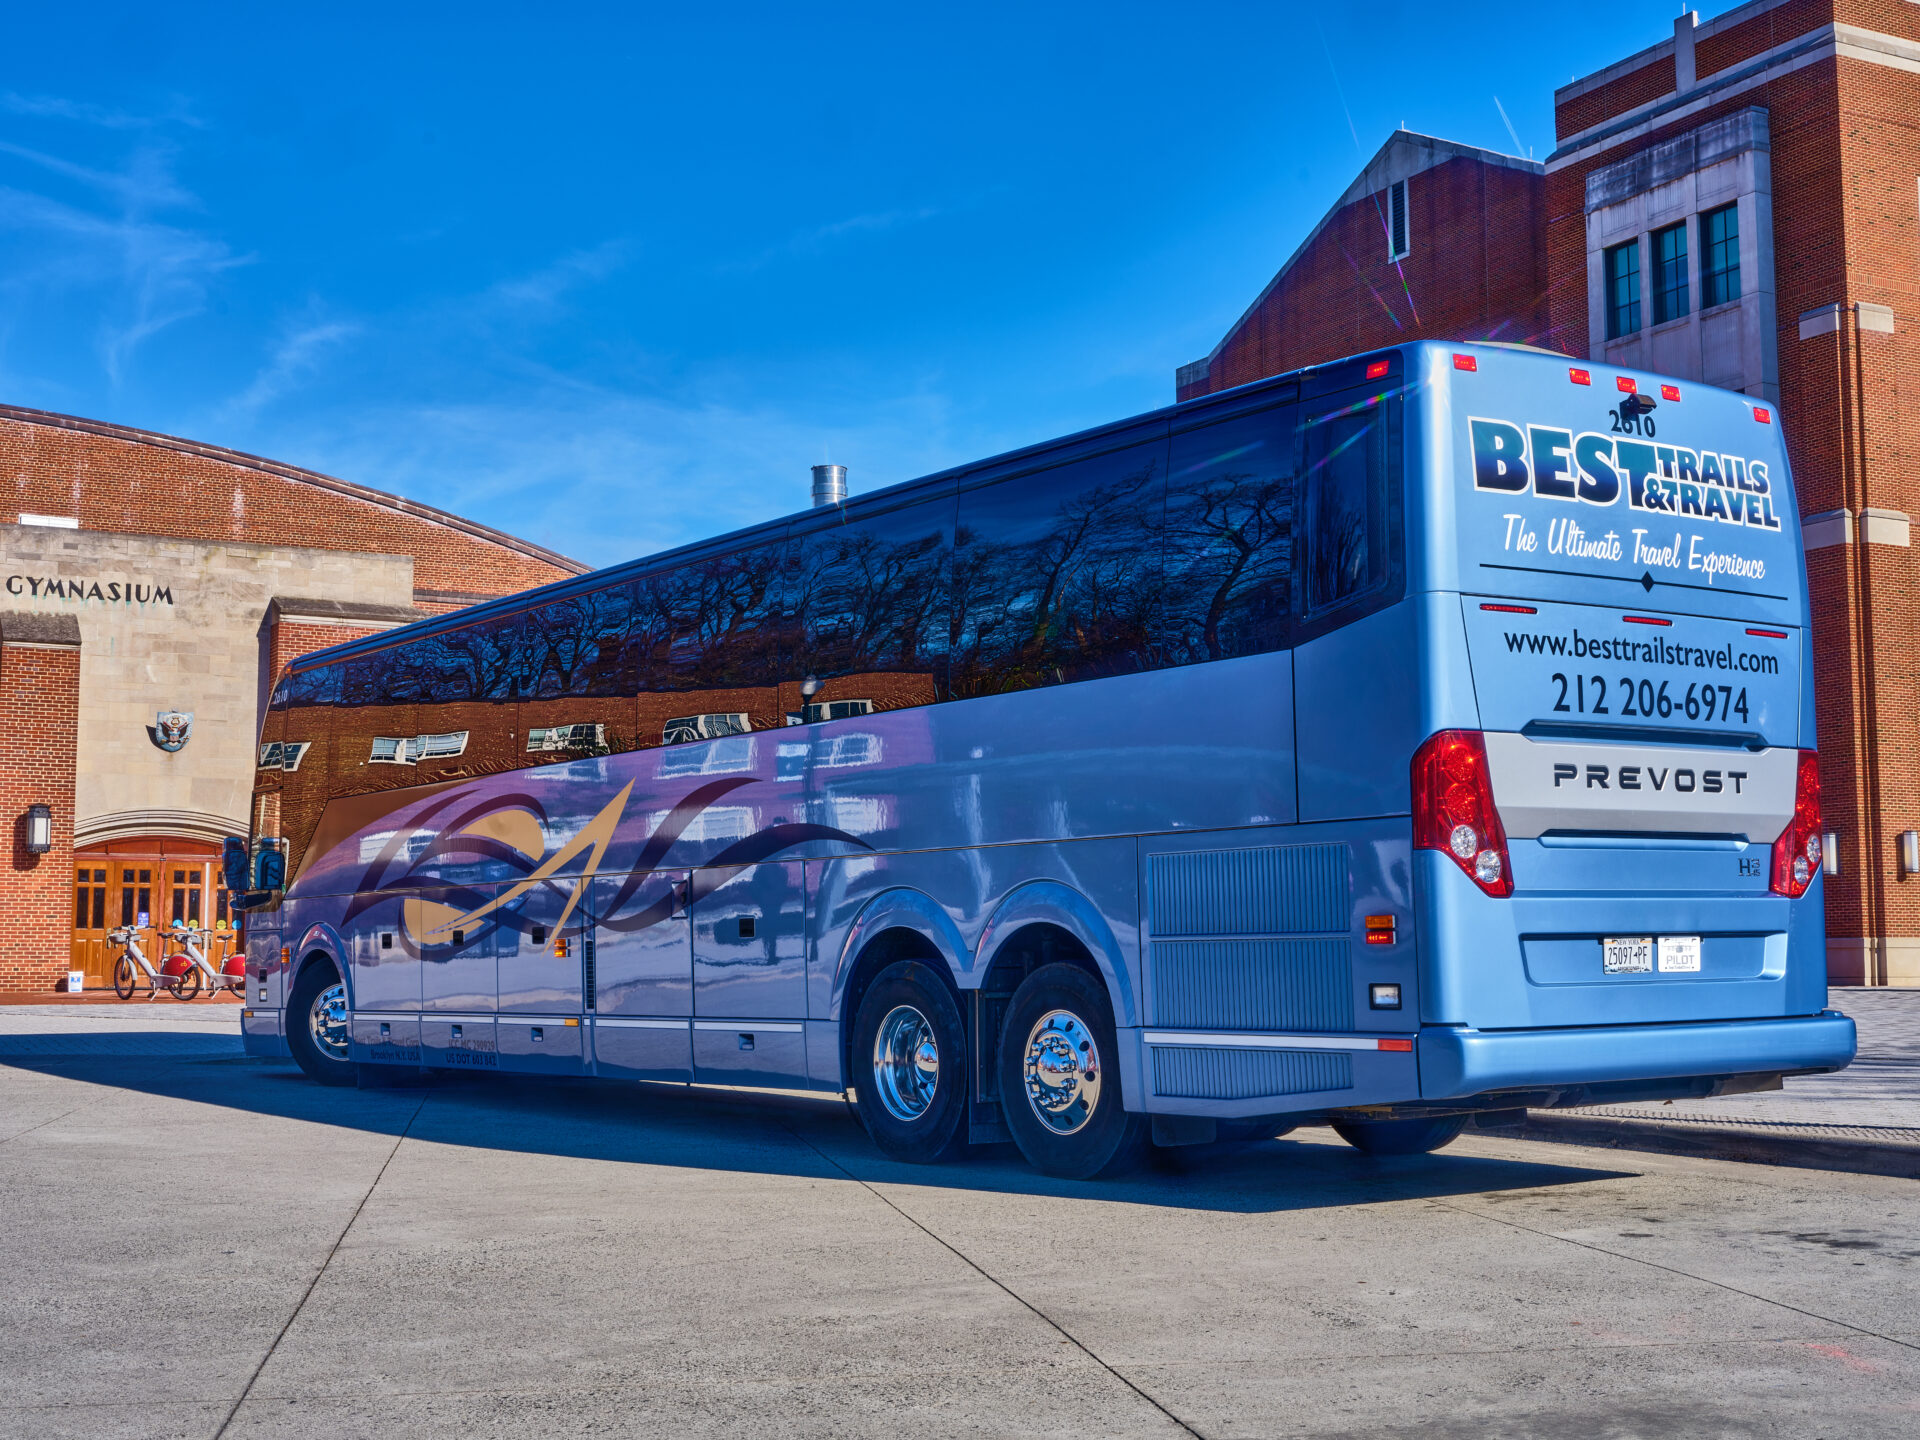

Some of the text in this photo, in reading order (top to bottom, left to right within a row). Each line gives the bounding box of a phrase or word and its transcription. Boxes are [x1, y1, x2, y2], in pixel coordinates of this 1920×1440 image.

[1609, 409, 1656, 438] 2610
[1468, 416, 1770, 509] BEST TRAILS
[1503, 514, 1766, 584] The Ultimate Travel Experience
[6, 575, 174, 605] GYMNASIUM
[1504, 629, 1779, 674] www.besttrailstravel.com
[1552, 673, 1749, 723] 212 206-6974
[1553, 763, 1748, 794] PREVOST
[1666, 955, 1695, 965] PILOT
[456, 1053, 470, 1064] DOT
